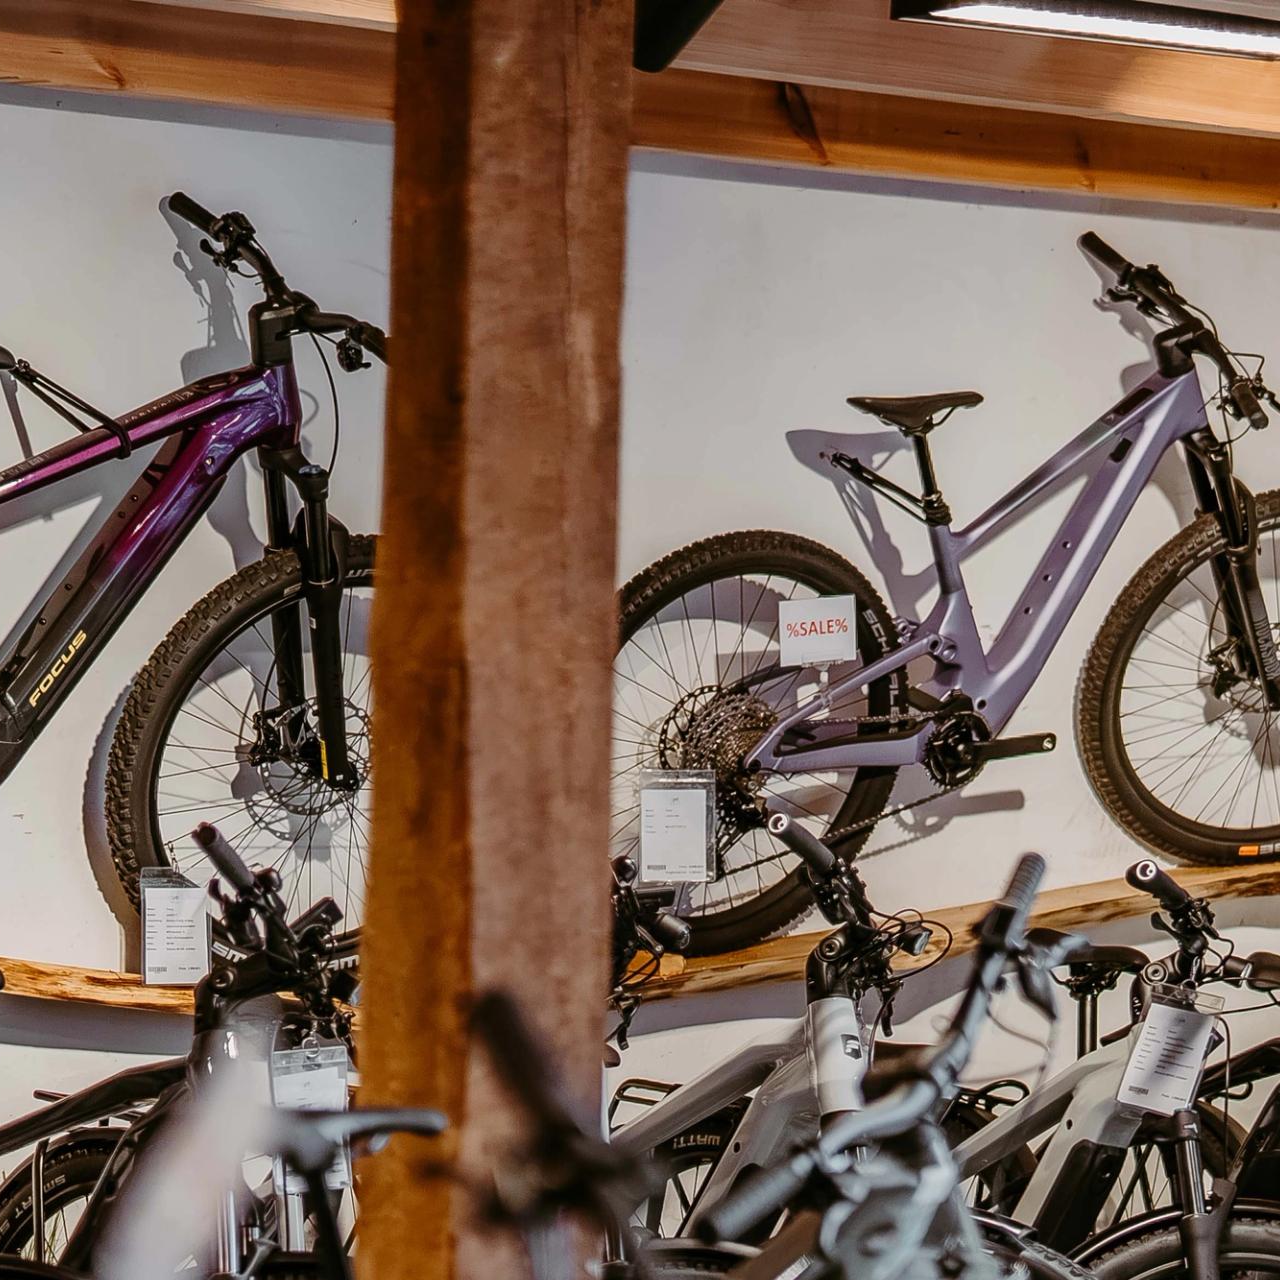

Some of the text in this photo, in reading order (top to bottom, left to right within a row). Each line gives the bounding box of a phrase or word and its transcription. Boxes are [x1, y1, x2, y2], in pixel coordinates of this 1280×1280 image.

[786, 618, 848, 638] %SALE%
[29, 629, 87, 707] FOCUS
[862, 608, 900, 735] SCHALBE
[317, 953, 360, 972] AM
